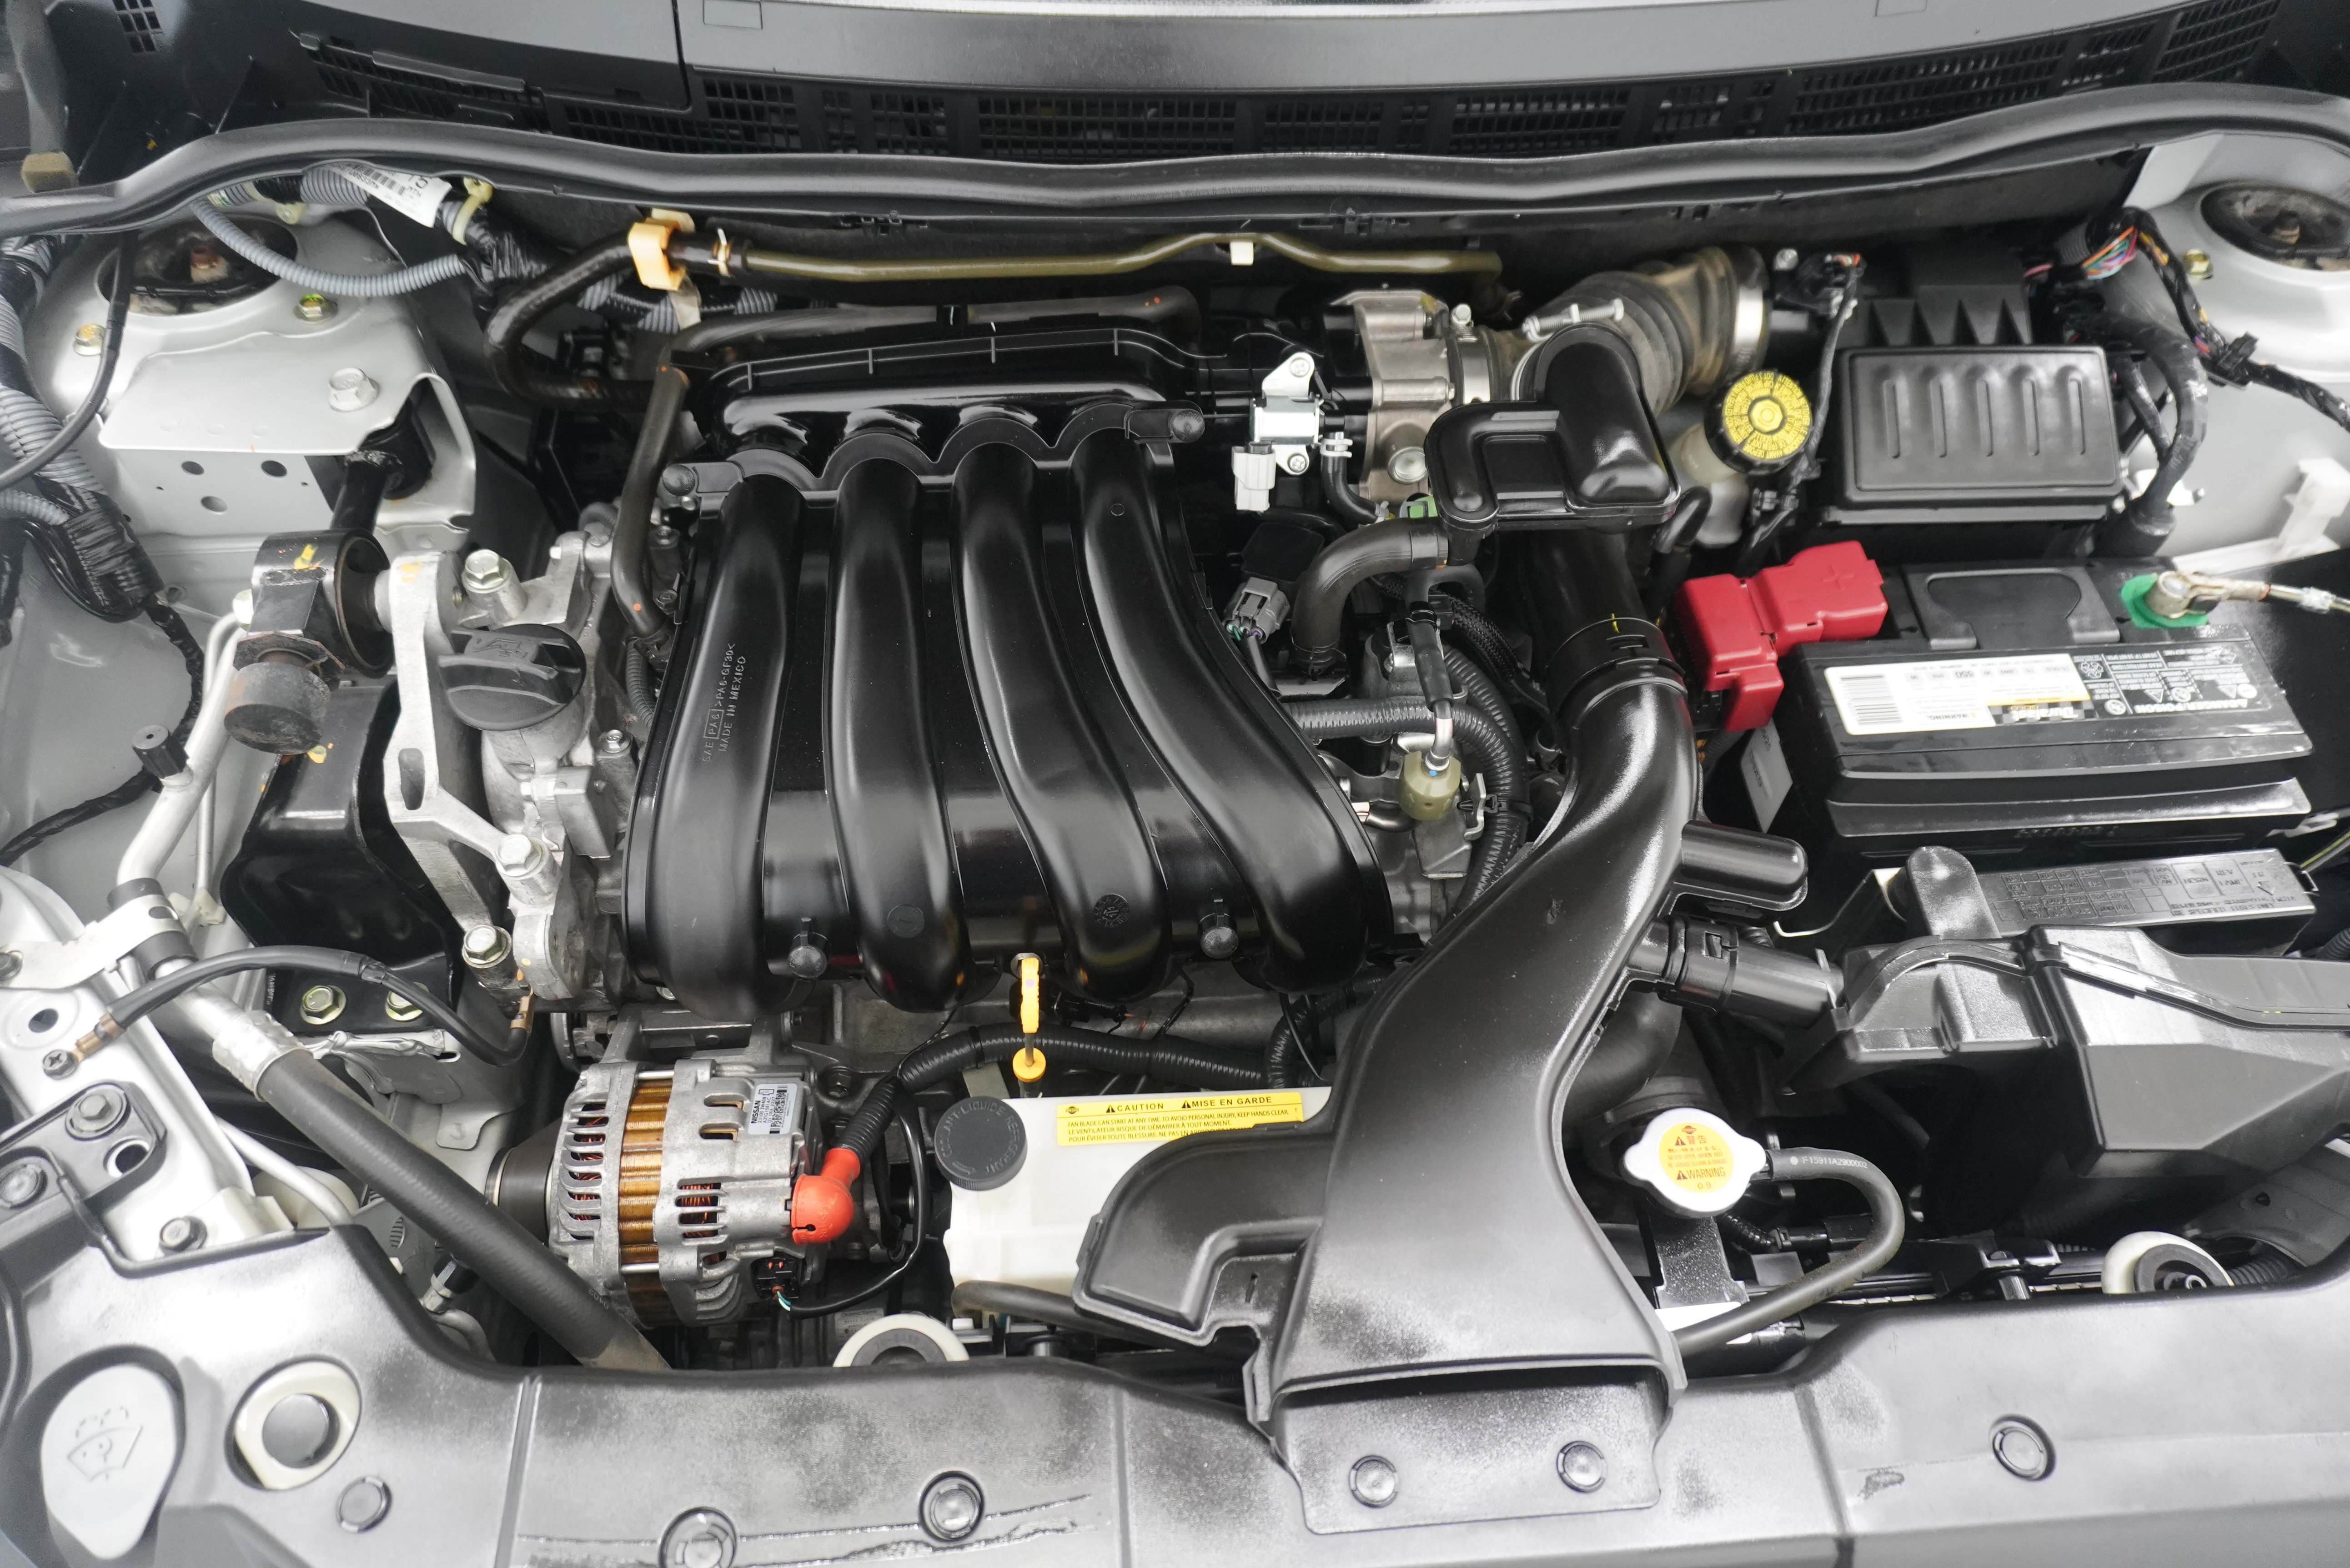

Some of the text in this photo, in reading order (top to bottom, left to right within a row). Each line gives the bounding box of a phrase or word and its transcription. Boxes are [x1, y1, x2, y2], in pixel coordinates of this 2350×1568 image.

[1724, 395, 1735, 415] SEALED
[1798, 426, 1808, 435] LE
[1782, 432, 1804, 454] BOUCHON
[1766, 448, 1783, 458] AVANT
[719, 656, 746, 751] MADE IN MEXICO
[2009, 707, 2079, 721] Duralast
[1117, 1103, 1164, 1111] CAUTION
[1237, 1096, 1272, 1105] GARDE
[751, 1101, 761, 1124] NISSAN
[1687, 1167, 1726, 1179] WARNING
